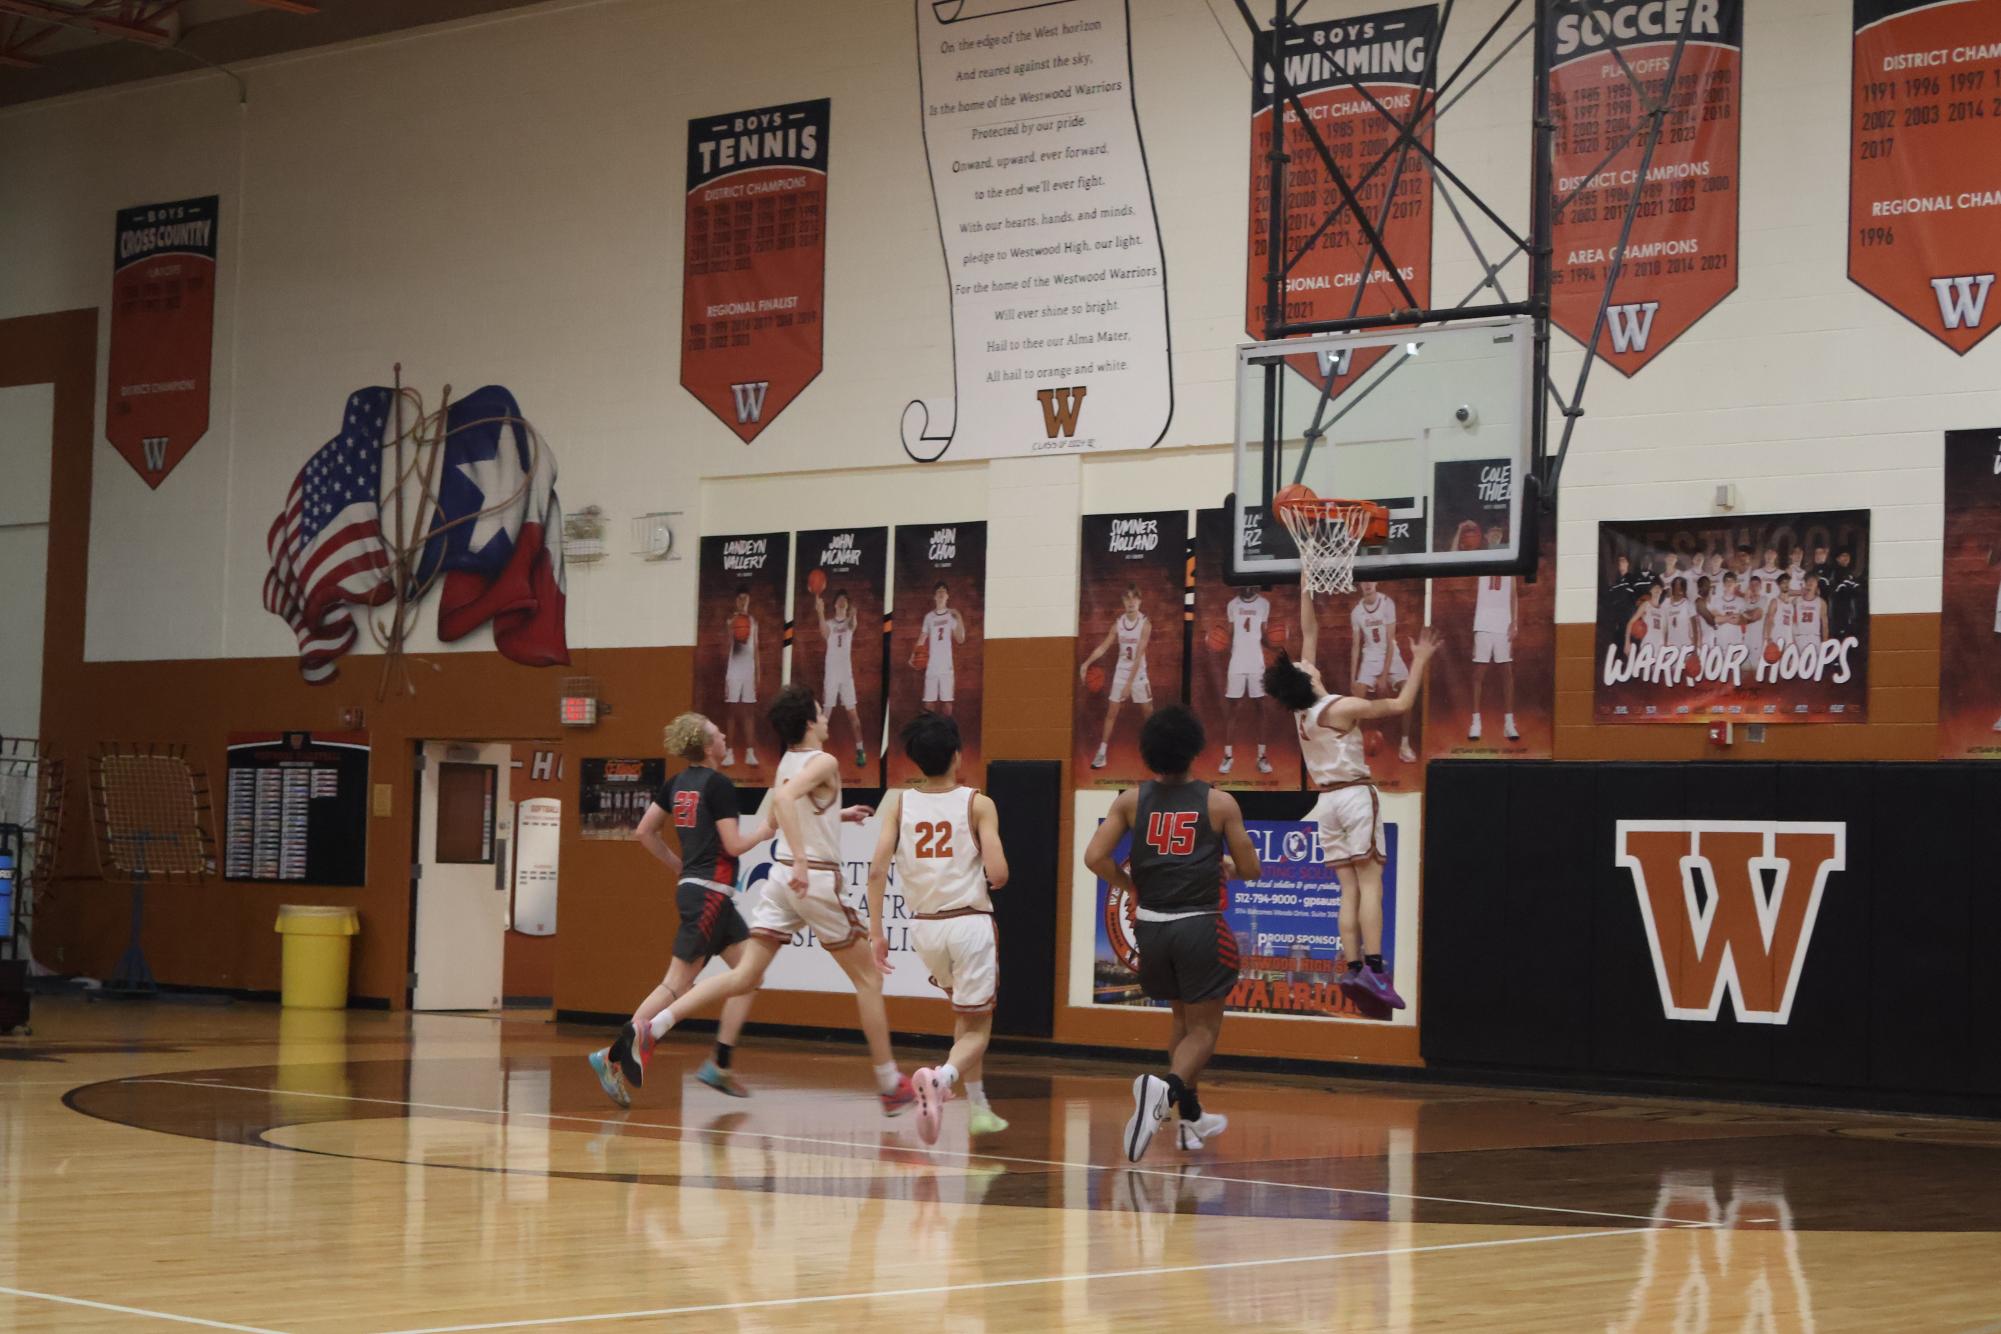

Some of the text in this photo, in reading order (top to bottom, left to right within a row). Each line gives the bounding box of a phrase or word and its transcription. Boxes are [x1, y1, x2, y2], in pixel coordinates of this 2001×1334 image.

[941, 20, 1101, 54] On the edge of the West horizon
[1313, 23, 1375, 46] BOYS
[1556, 0, 1720, 55] SOCCER
[956, 69, 976, 81] And
[979, 64, 1010, 78] reared
[1014, 60, 1050, 76] against
[1053, 56, 1069, 68] the
[1883, 49, 1948, 71] DISTRICT
[929, 80, 1122, 116] Is the home of the Westwood Warriors
[1863, 81, 1896, 102] 1991
[1905, 77, 1940, 97] 1996
[1950, 71, 1985, 92] 1997
[1332, 94, 1411, 117] CHAMIONS
[1948, 100, 1985, 122] 2014
[734, 112, 782, 132] BOYS
[972, 122, 1019, 140] Protected
[1021, 123, 1034, 137] by
[1036, 120, 1053, 132] our
[699, 125, 817, 174] TENNIS
[1040, 150, 1061, 161] ever
[1861, 138, 1894, 160] 2017
[704, 176, 806, 201] DISTRICT CHAMPIONS
[975, 190, 984, 200] to
[987, 187, 1002, 198] the
[1005, 184, 1024, 196] end
[1052, 180, 1074, 190] ever
[147, 207, 184, 222] BOYS
[1872, 196, 1953, 216] REGIONAL
[959, 221, 983, 233] With
[985, 220, 1002, 231] our
[1077, 209, 1097, 221] and
[157, 219, 212, 247] COUNTRY
[1860, 227, 1894, 247] 1996
[963, 251, 995, 267] pledge
[997, 250, 1007, 261] to
[1010, 243, 1061, 258] Westwood
[1095, 238, 1113, 249] our
[1568, 248, 1605, 265] AREA
[955, 265, 1158, 295] For the home of the Westwood Warriors
[707, 296, 798, 317] REGIONAL FINALIST
[995, 309, 1015, 321] Will
[1017, 308, 1038, 319] ever
[1041, 304, 1068, 317] shine
[1071, 304, 1082, 315] so
[1930, 273, 1996, 329] W
[1606, 302, 1659, 353] W
[987, 339, 1008, 352] Hail
[1010, 339, 1020, 350] to
[1022, 338, 1044, 350] thee
[1047, 336, 1063, 347] our
[1067, 333, 1094, 346] Alma
[986, 371, 1001, 382] All
[1003, 368, 1022, 380] hail
[1025, 368, 1034, 379] to
[1037, 367, 1071, 380] orange
[1075, 363, 1094, 375] and
[731, 382, 768, 424] W
[1037, 386, 1087, 438] W
[143, 437, 169, 470] W
[1110, 518, 1158, 536] SUMNER
[1109, 533, 1159, 552] HOLLAND
[723, 554, 767, 571] VALLERY
[1756, 637, 1858, 684] HOOPS
[915, 820, 953, 858] 22
[1147, 812, 1199, 856] 45
[1616, 819, 1846, 1025] W
[1258, 933, 1295, 947] PROUD
